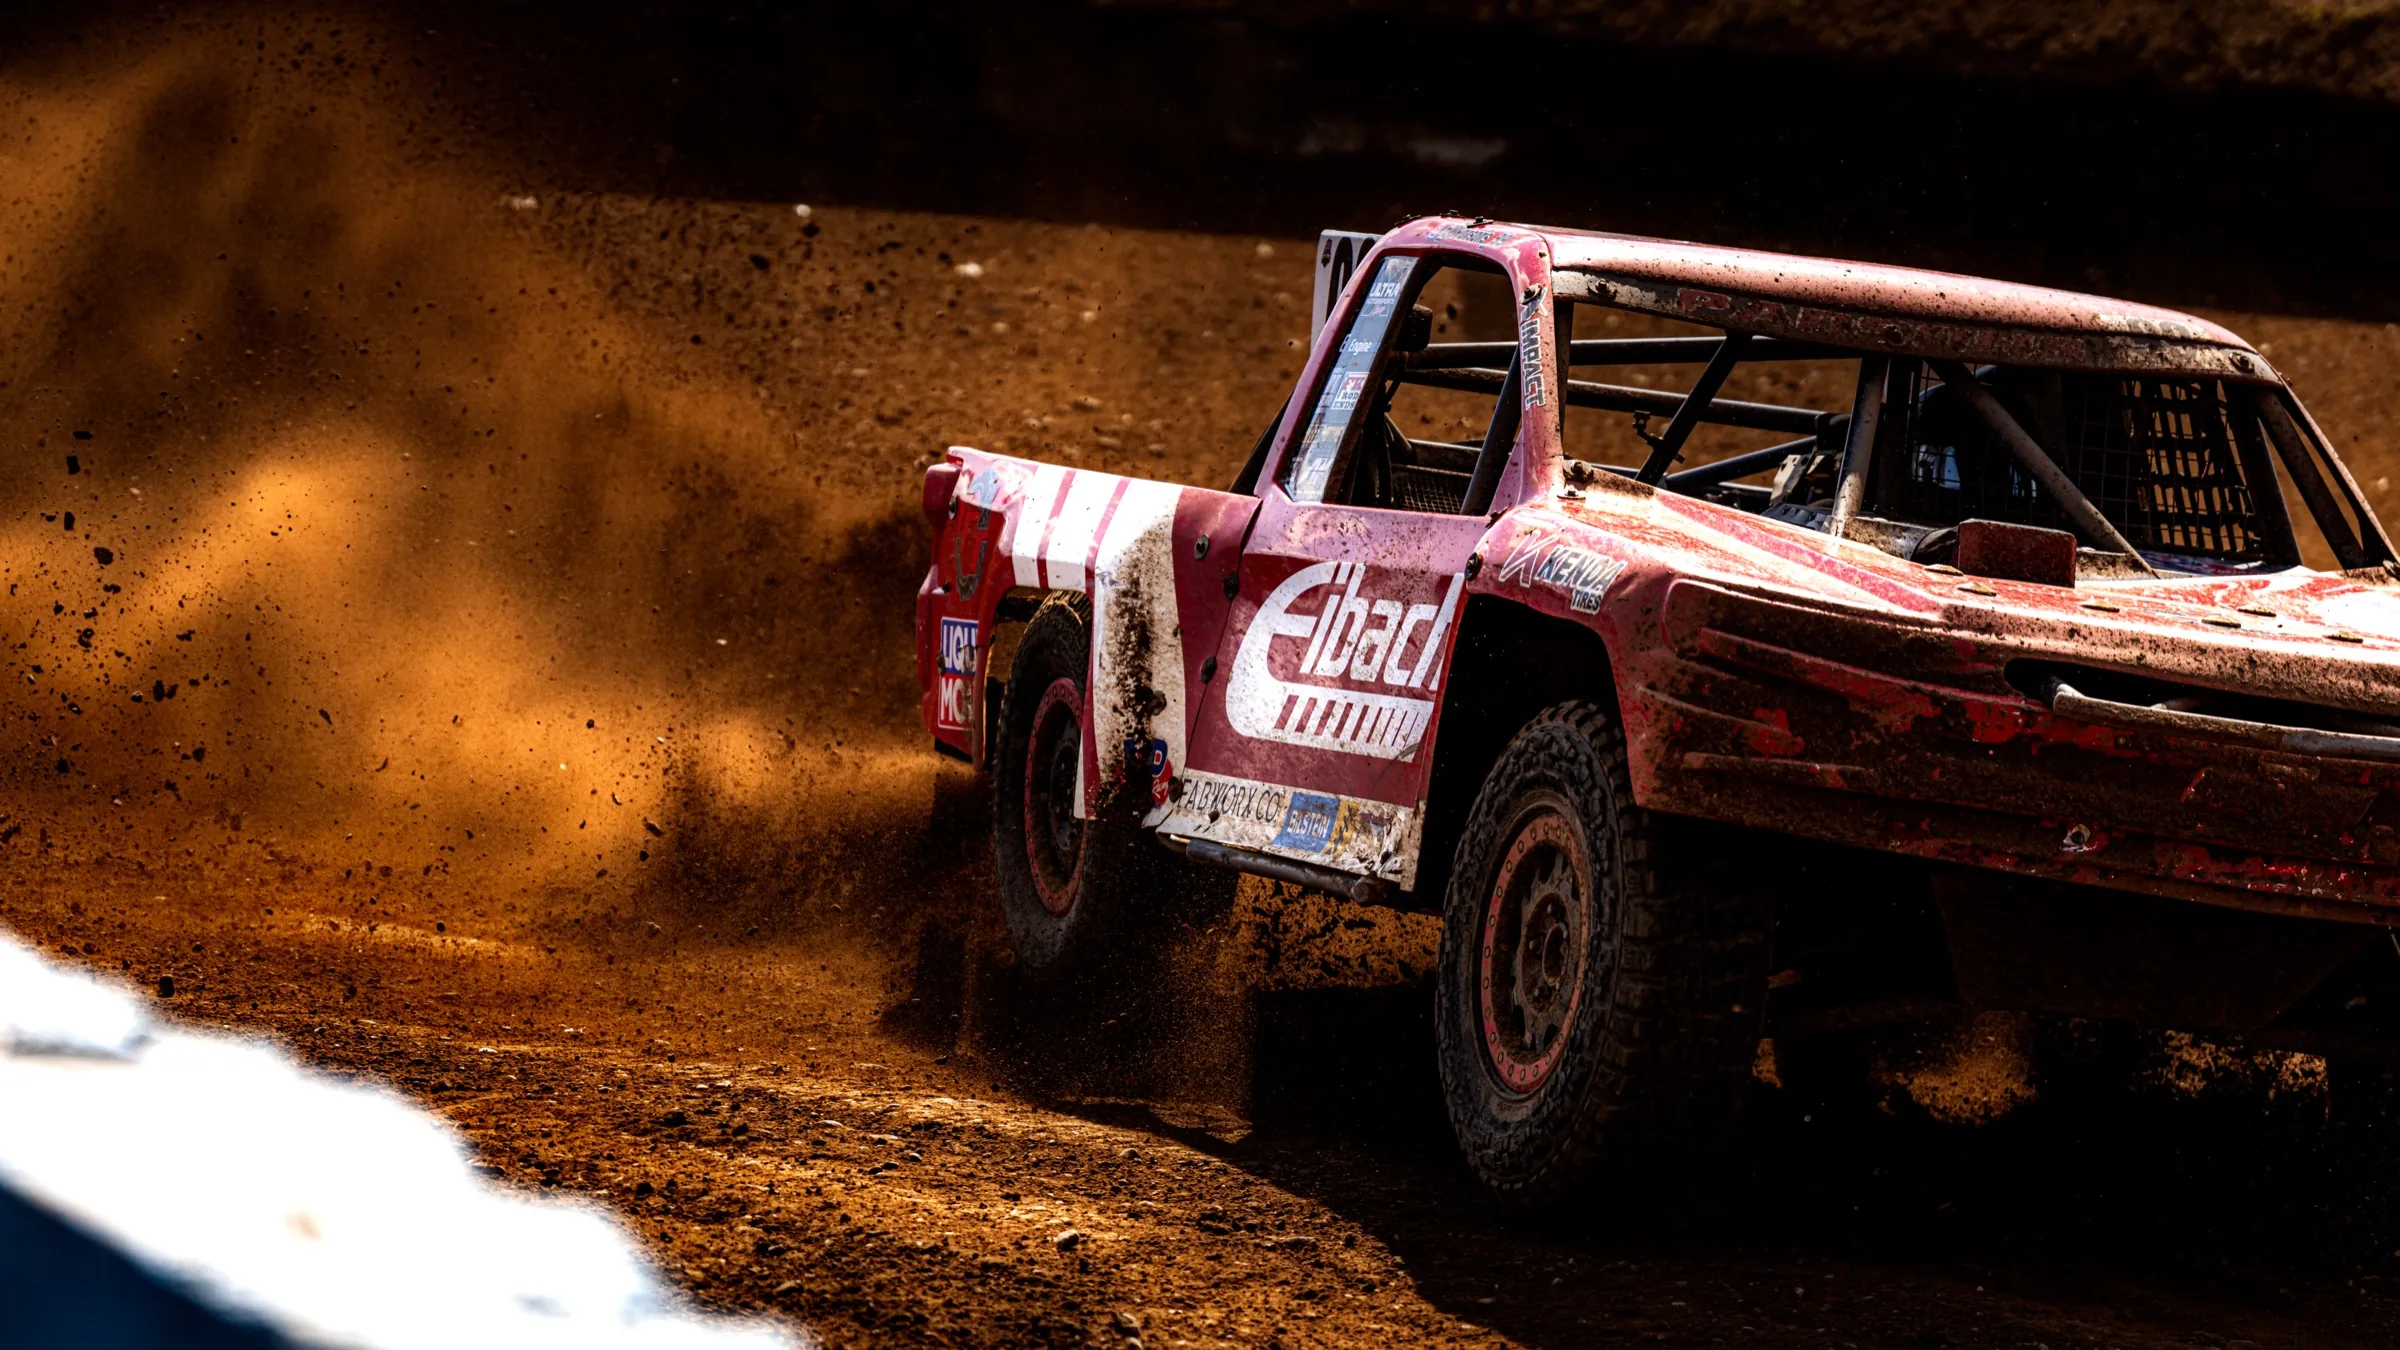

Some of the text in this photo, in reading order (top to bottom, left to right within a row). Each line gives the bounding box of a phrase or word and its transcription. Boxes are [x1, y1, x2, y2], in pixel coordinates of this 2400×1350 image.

[1369, 283, 1401, 297] ULTRA
[1348, 339, 1373, 355] Engine
[1520, 319, 1546, 410] IMPACT
[1534, 545, 1627, 592] KENDA
[1572, 589, 1602, 612] TIRES
[943, 625, 979, 673] LIQU
[1177, 778, 1258, 818] FABWORX
[1286, 809, 1331, 839] BILSTEIN
